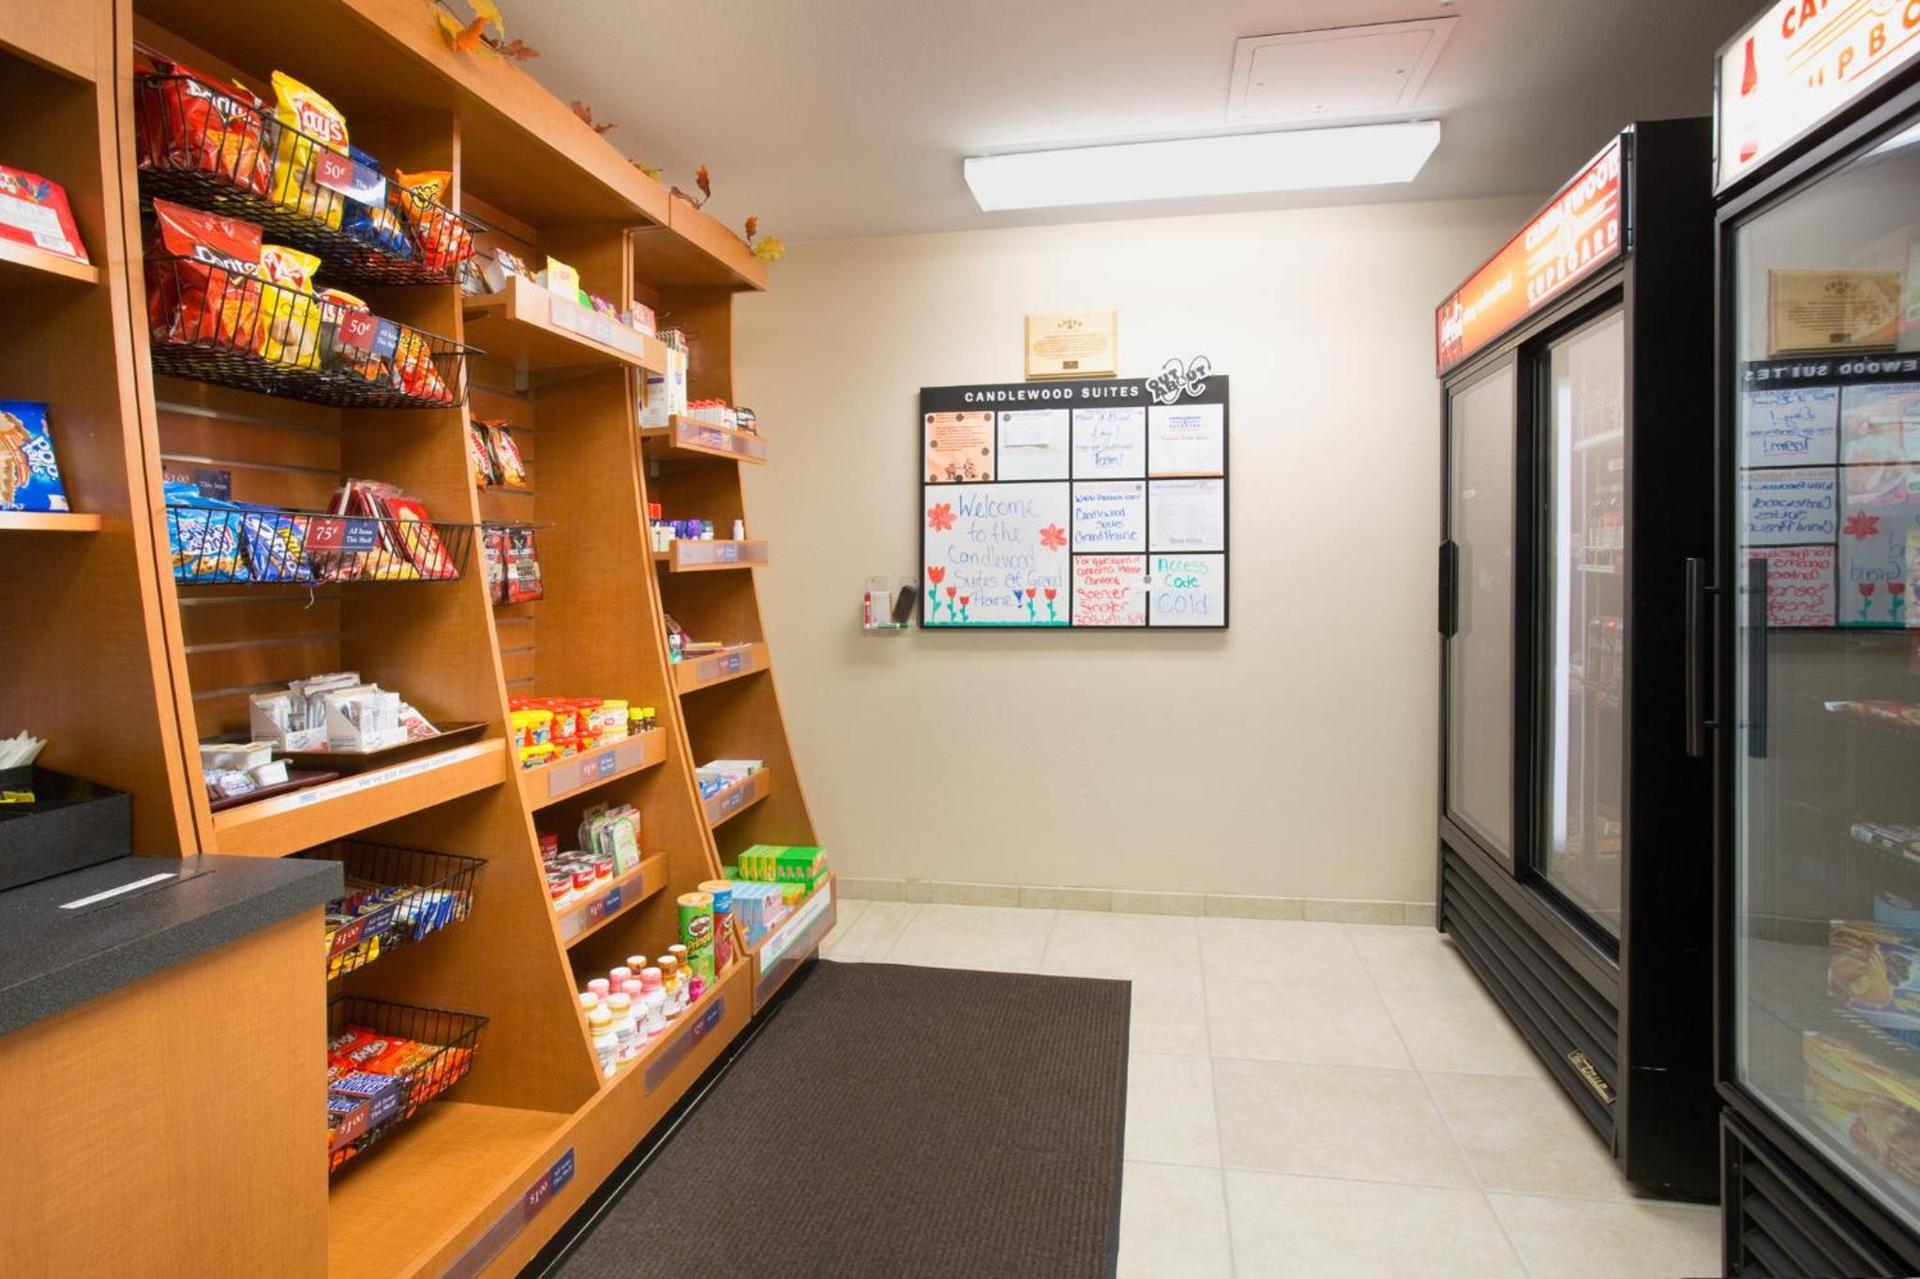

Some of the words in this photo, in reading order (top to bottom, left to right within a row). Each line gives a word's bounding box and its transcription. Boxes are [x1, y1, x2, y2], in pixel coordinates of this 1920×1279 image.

[964, 388, 1073, 403] CANDLEWOOD
[1081, 386, 1139, 399] SUITES
[959, 492, 1039, 519] Welcome
[316, 526, 338, 541] 75¢
[967, 521, 988, 543] to
[991, 522, 1022, 544] the
[1157, 557, 1209, 574] Access
[1164, 574, 1199, 589] Code
